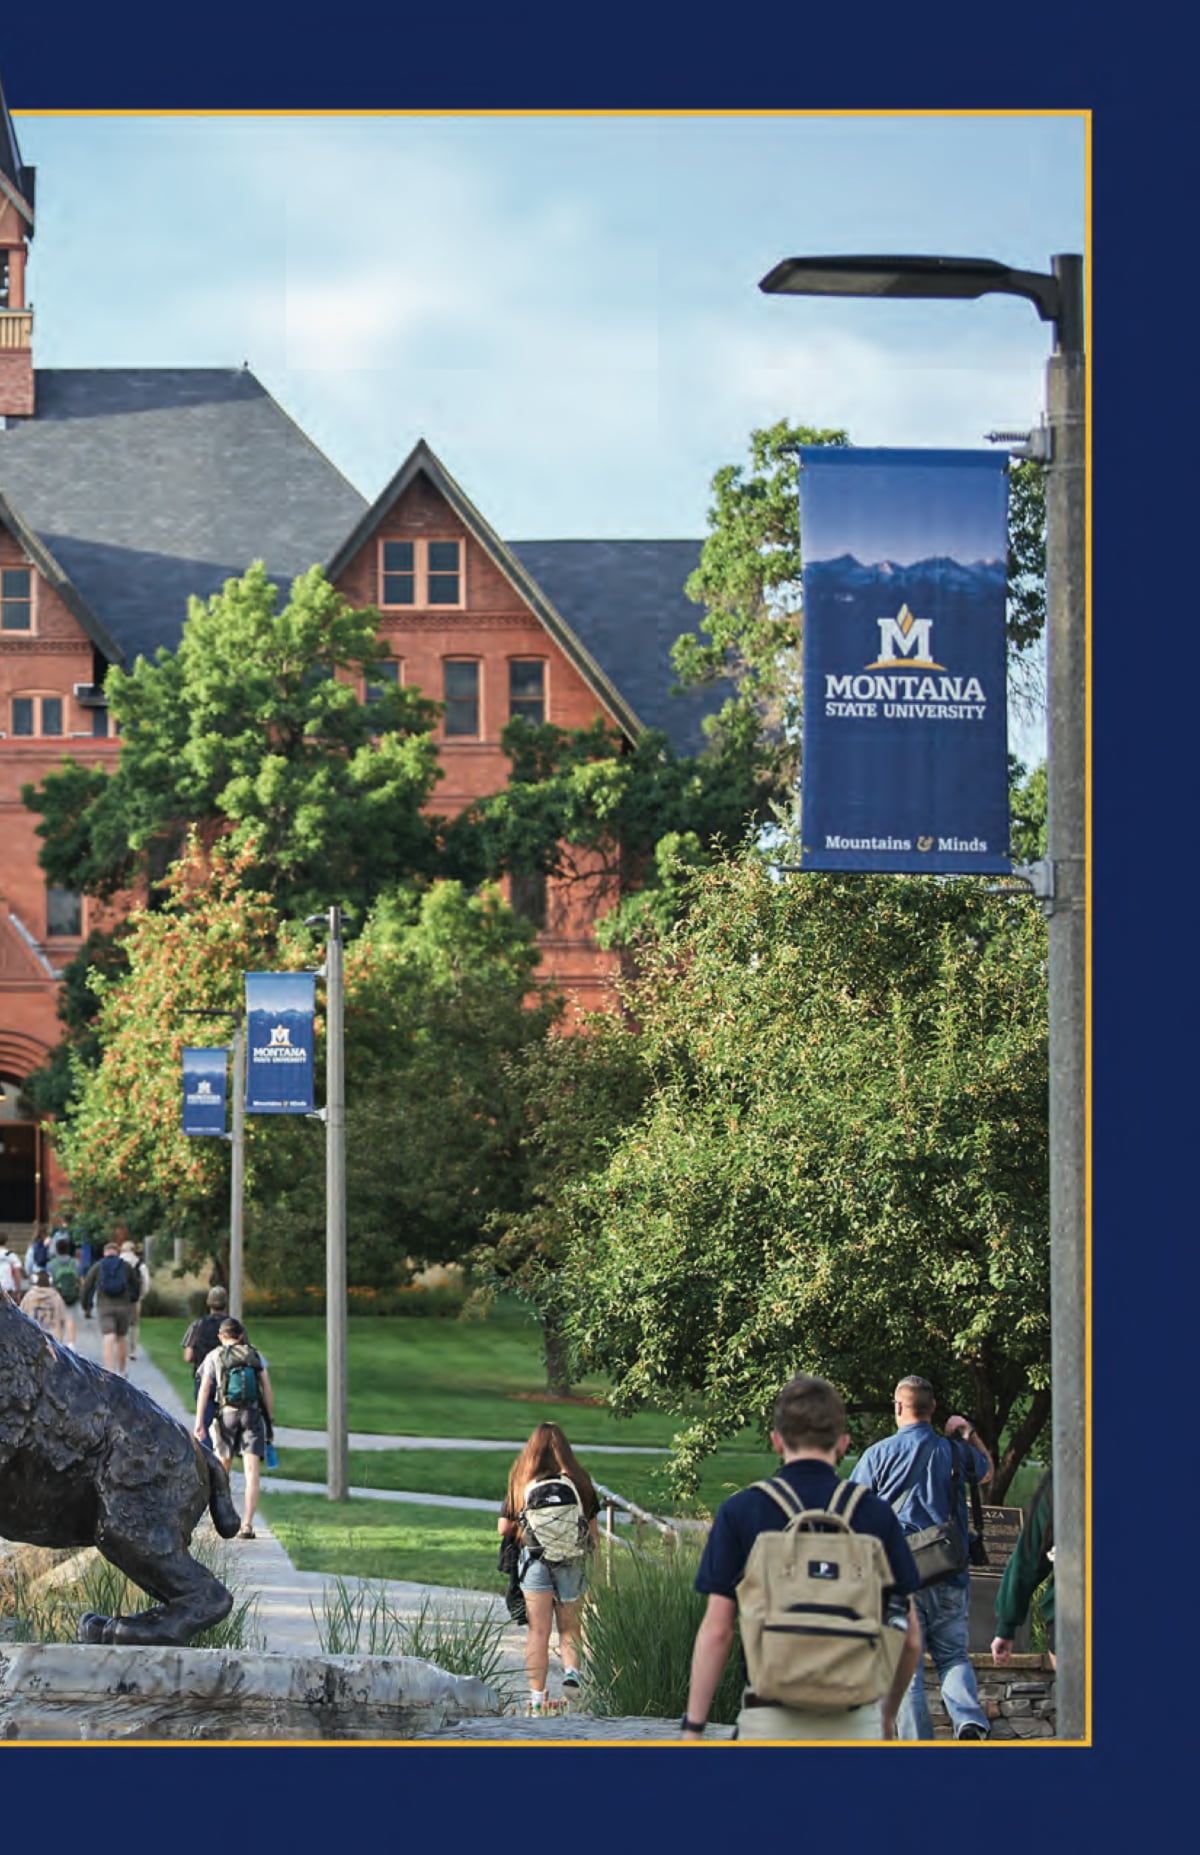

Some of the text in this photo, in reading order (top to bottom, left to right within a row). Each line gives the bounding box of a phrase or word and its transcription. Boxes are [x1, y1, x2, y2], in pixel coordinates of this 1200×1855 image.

[876, 617, 934, 664] M
[824, 674, 987, 703] MONTANA
[825, 702, 987, 720] STATE UNIVERSITY
[825, 835, 988, 852] Mountains & Minds
[253, 1047, 307, 1057] MONTANA
[981, 1511, 1004, 1519] AZA
